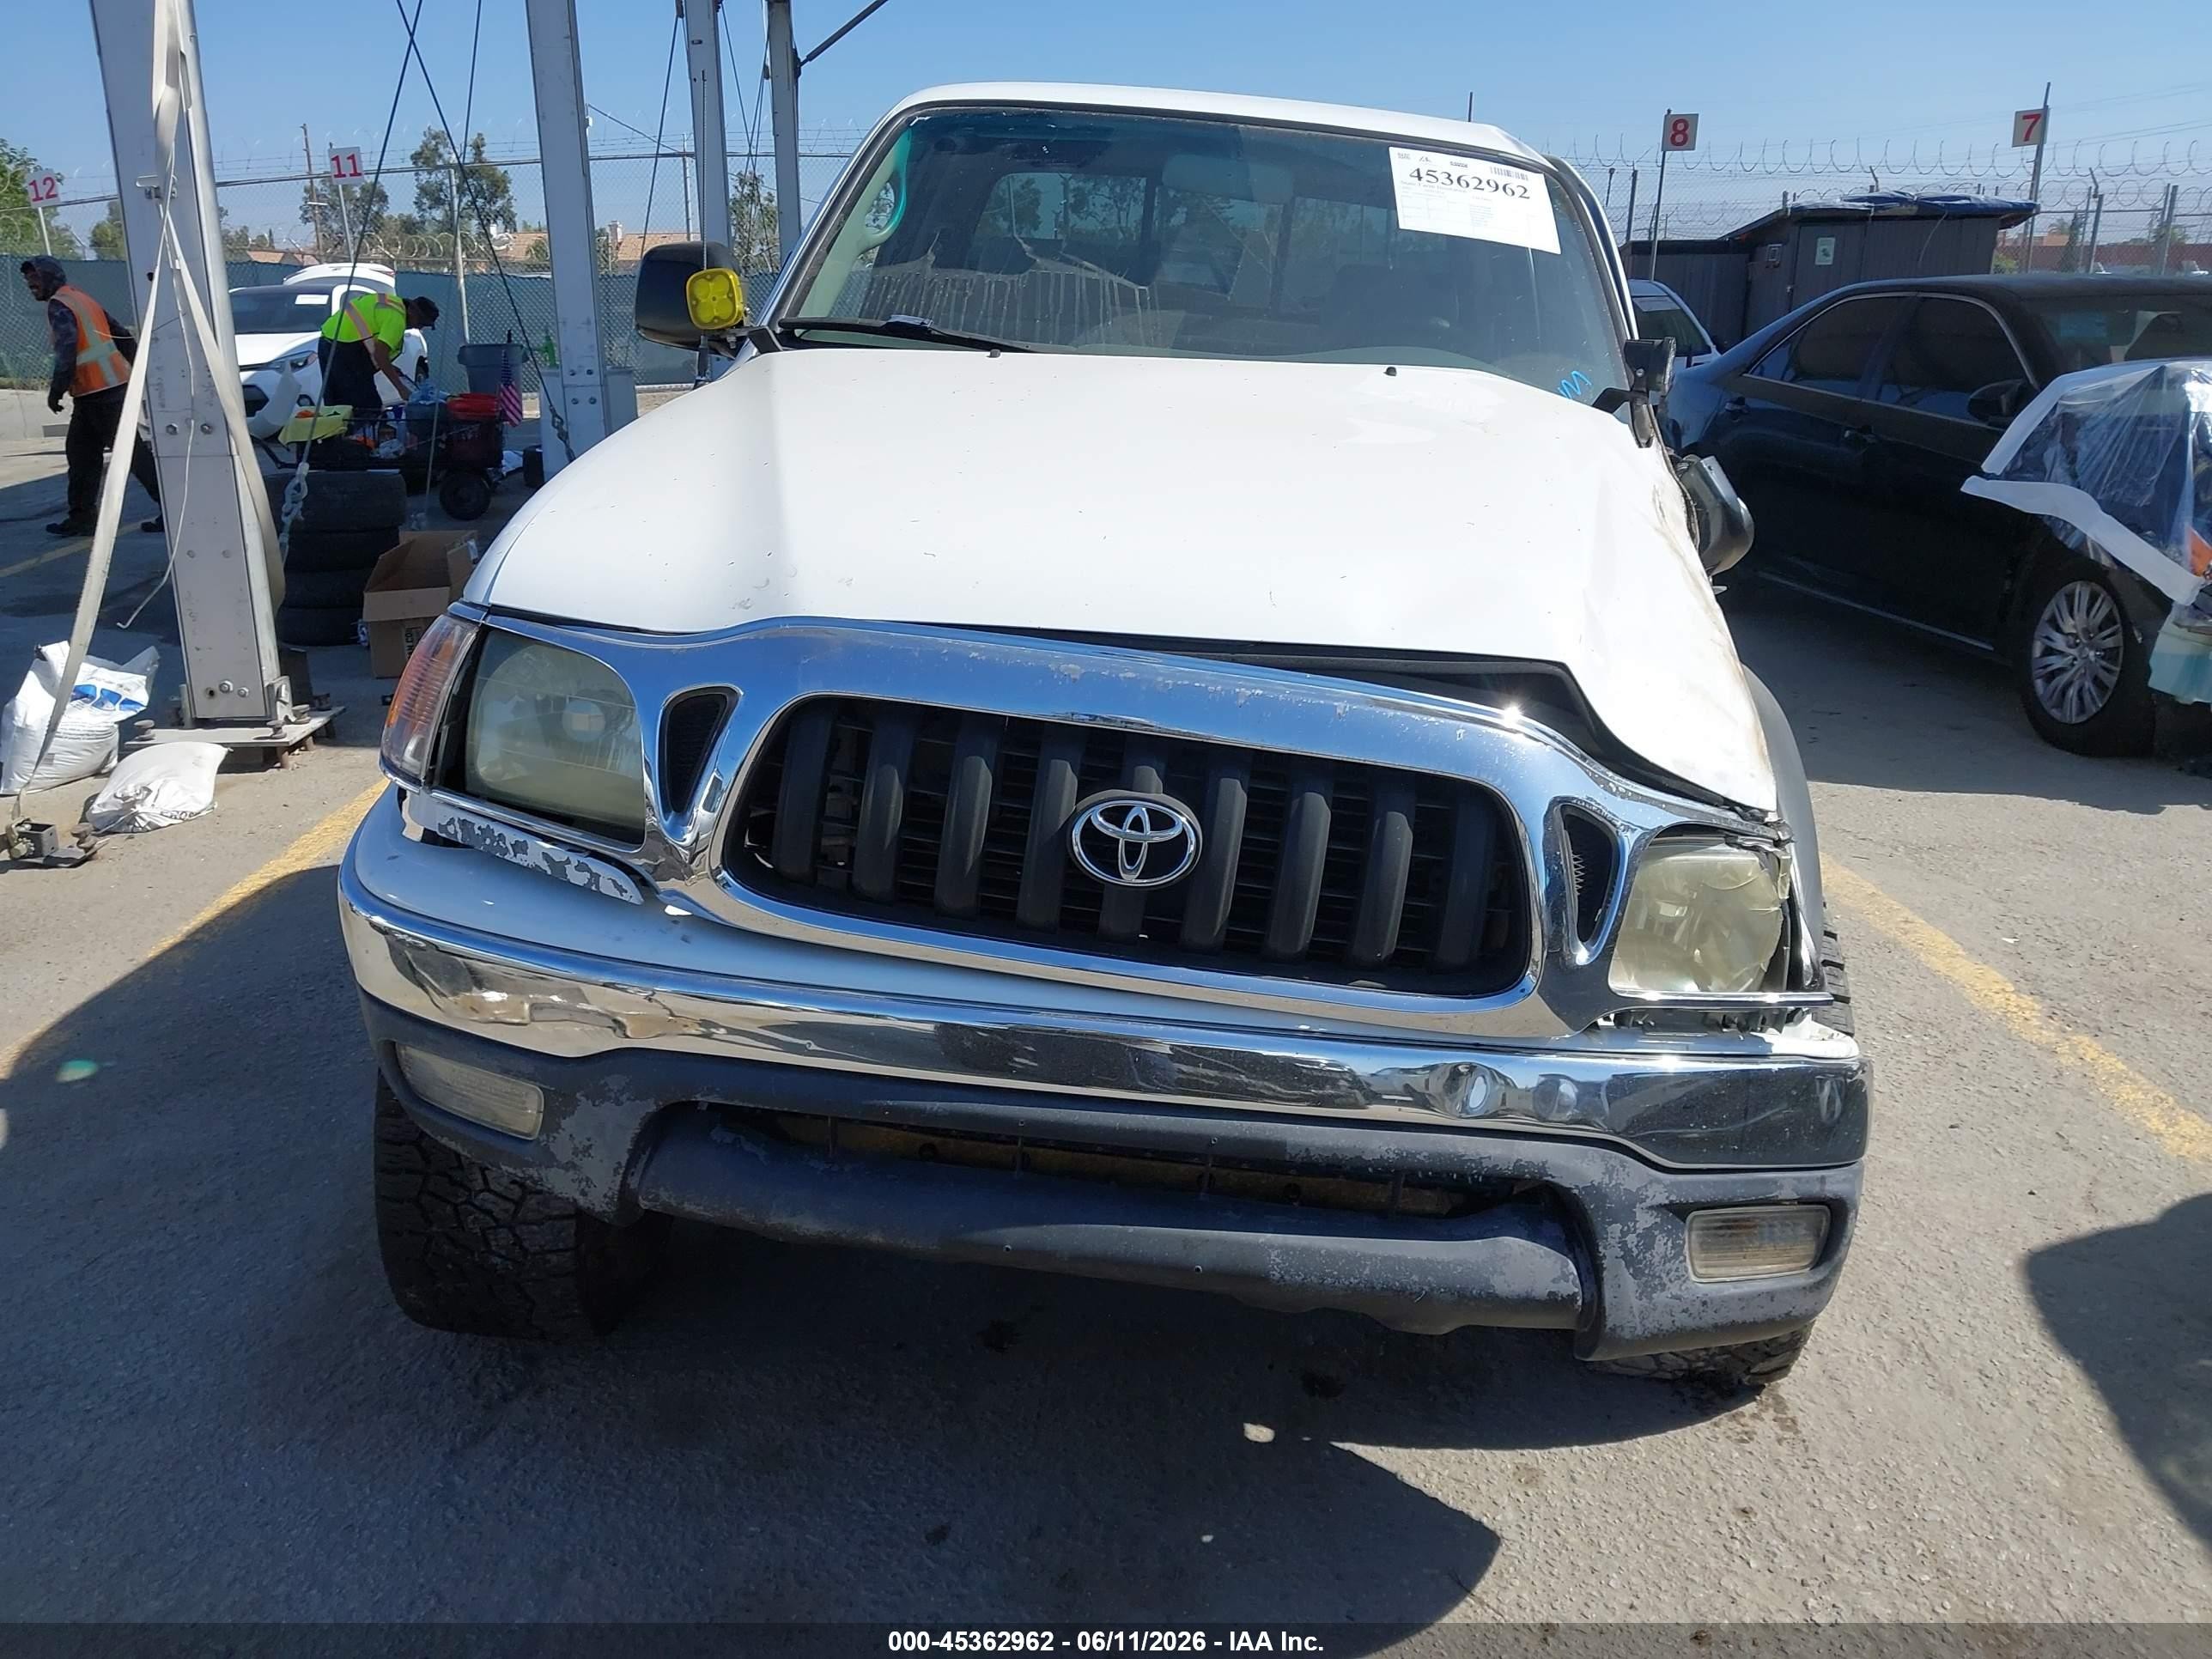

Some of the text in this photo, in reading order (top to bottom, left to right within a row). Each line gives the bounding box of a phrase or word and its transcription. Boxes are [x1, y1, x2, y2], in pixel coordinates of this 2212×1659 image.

[1669, 118, 1690, 146] 8
[2021, 113, 2041, 142] 7
[331, 154, 362, 179] 11
[27, 176, 58, 203] 12
[1409, 167, 1530, 199] 45362962
